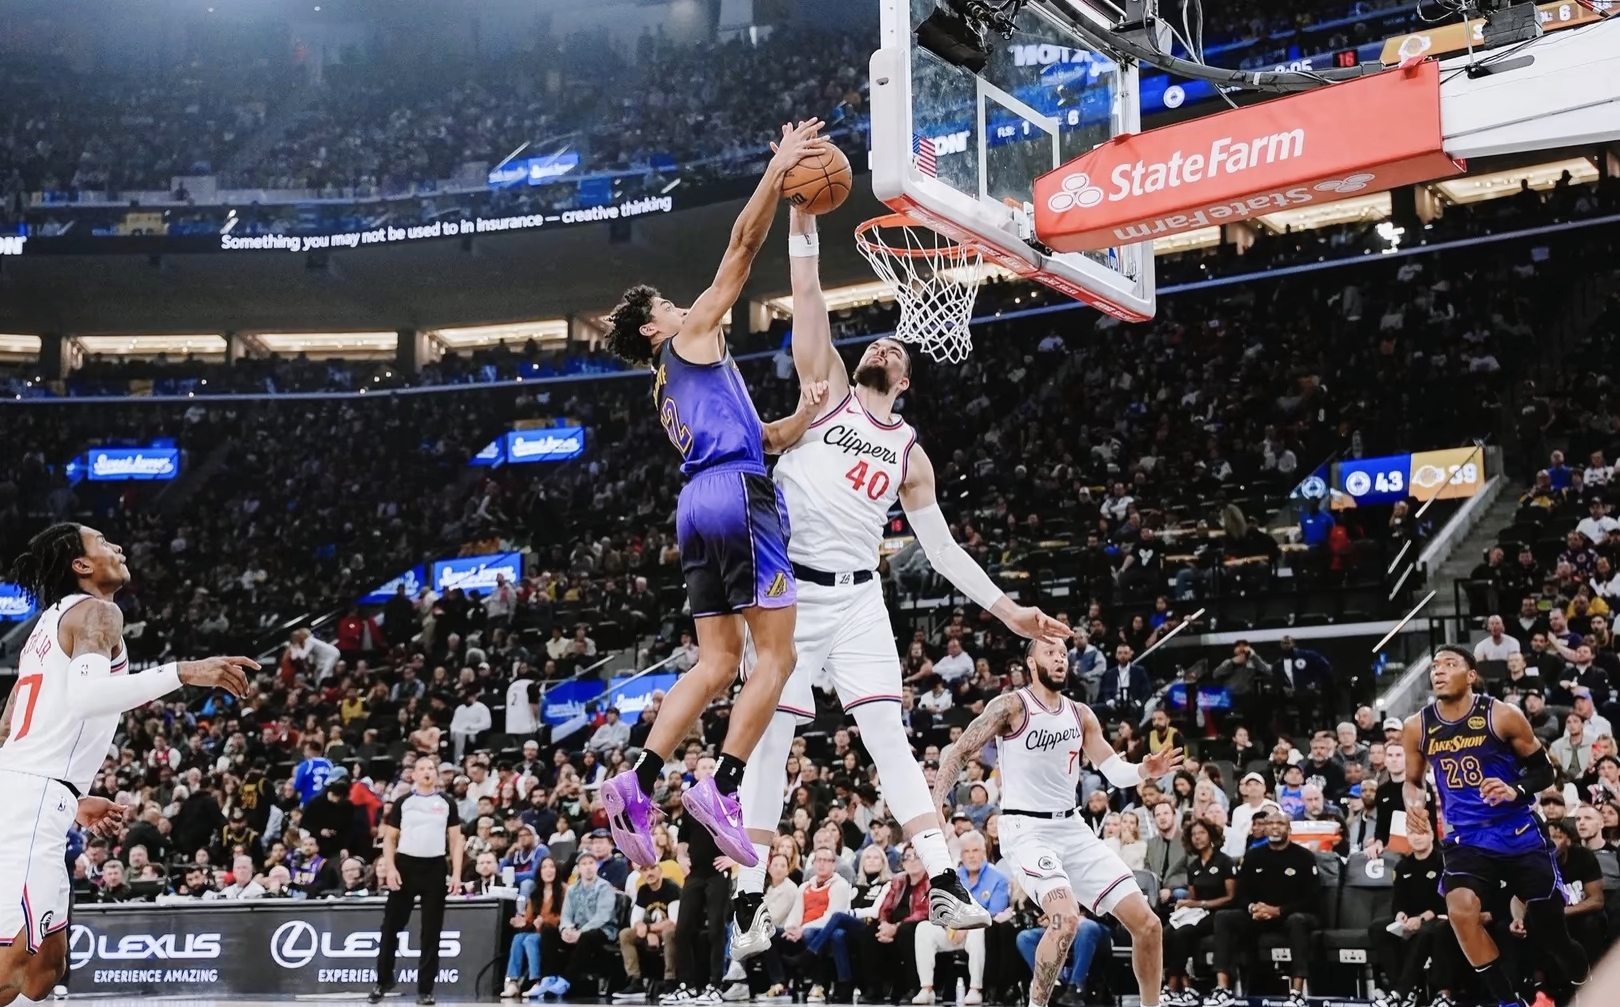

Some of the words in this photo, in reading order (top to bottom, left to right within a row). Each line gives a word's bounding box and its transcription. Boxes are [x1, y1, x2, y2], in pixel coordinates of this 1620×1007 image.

[1021, 119, 1029, 135] 1
[1109, 151, 1205, 201] State
[1207, 128, 1305, 178] Farm
[221, 233, 301, 252] Something
[301, 235, 330, 251] you
[330, 232, 361, 247] may
[361, 228, 386, 243] not
[387, 225, 406, 240] be
[407, 221, 441, 237] used
[442, 221, 459, 235] to
[460, 219, 475, 234] in
[476, 213, 544, 232] insurance
[561, 205, 619, 224] creative
[620, 195, 673, 217] thinking
[823, 425, 897, 465] Clippers
[845, 460, 890, 501] 40
[1374, 471, 1404, 493] 43
[1449, 463, 1478, 485] 39
[1025, 728, 1081, 752] Clippers
[1068, 750, 1078, 775] 7
[1440, 756, 1483, 789] 28
[1047, 888, 1068, 903] JUST
[98, 934, 221, 959] LEXUS
[94, 969, 163, 983] EXPERIENCE
[163, 969, 218, 983] AMAZING
[318, 969, 397, 983] EXPERIEN
